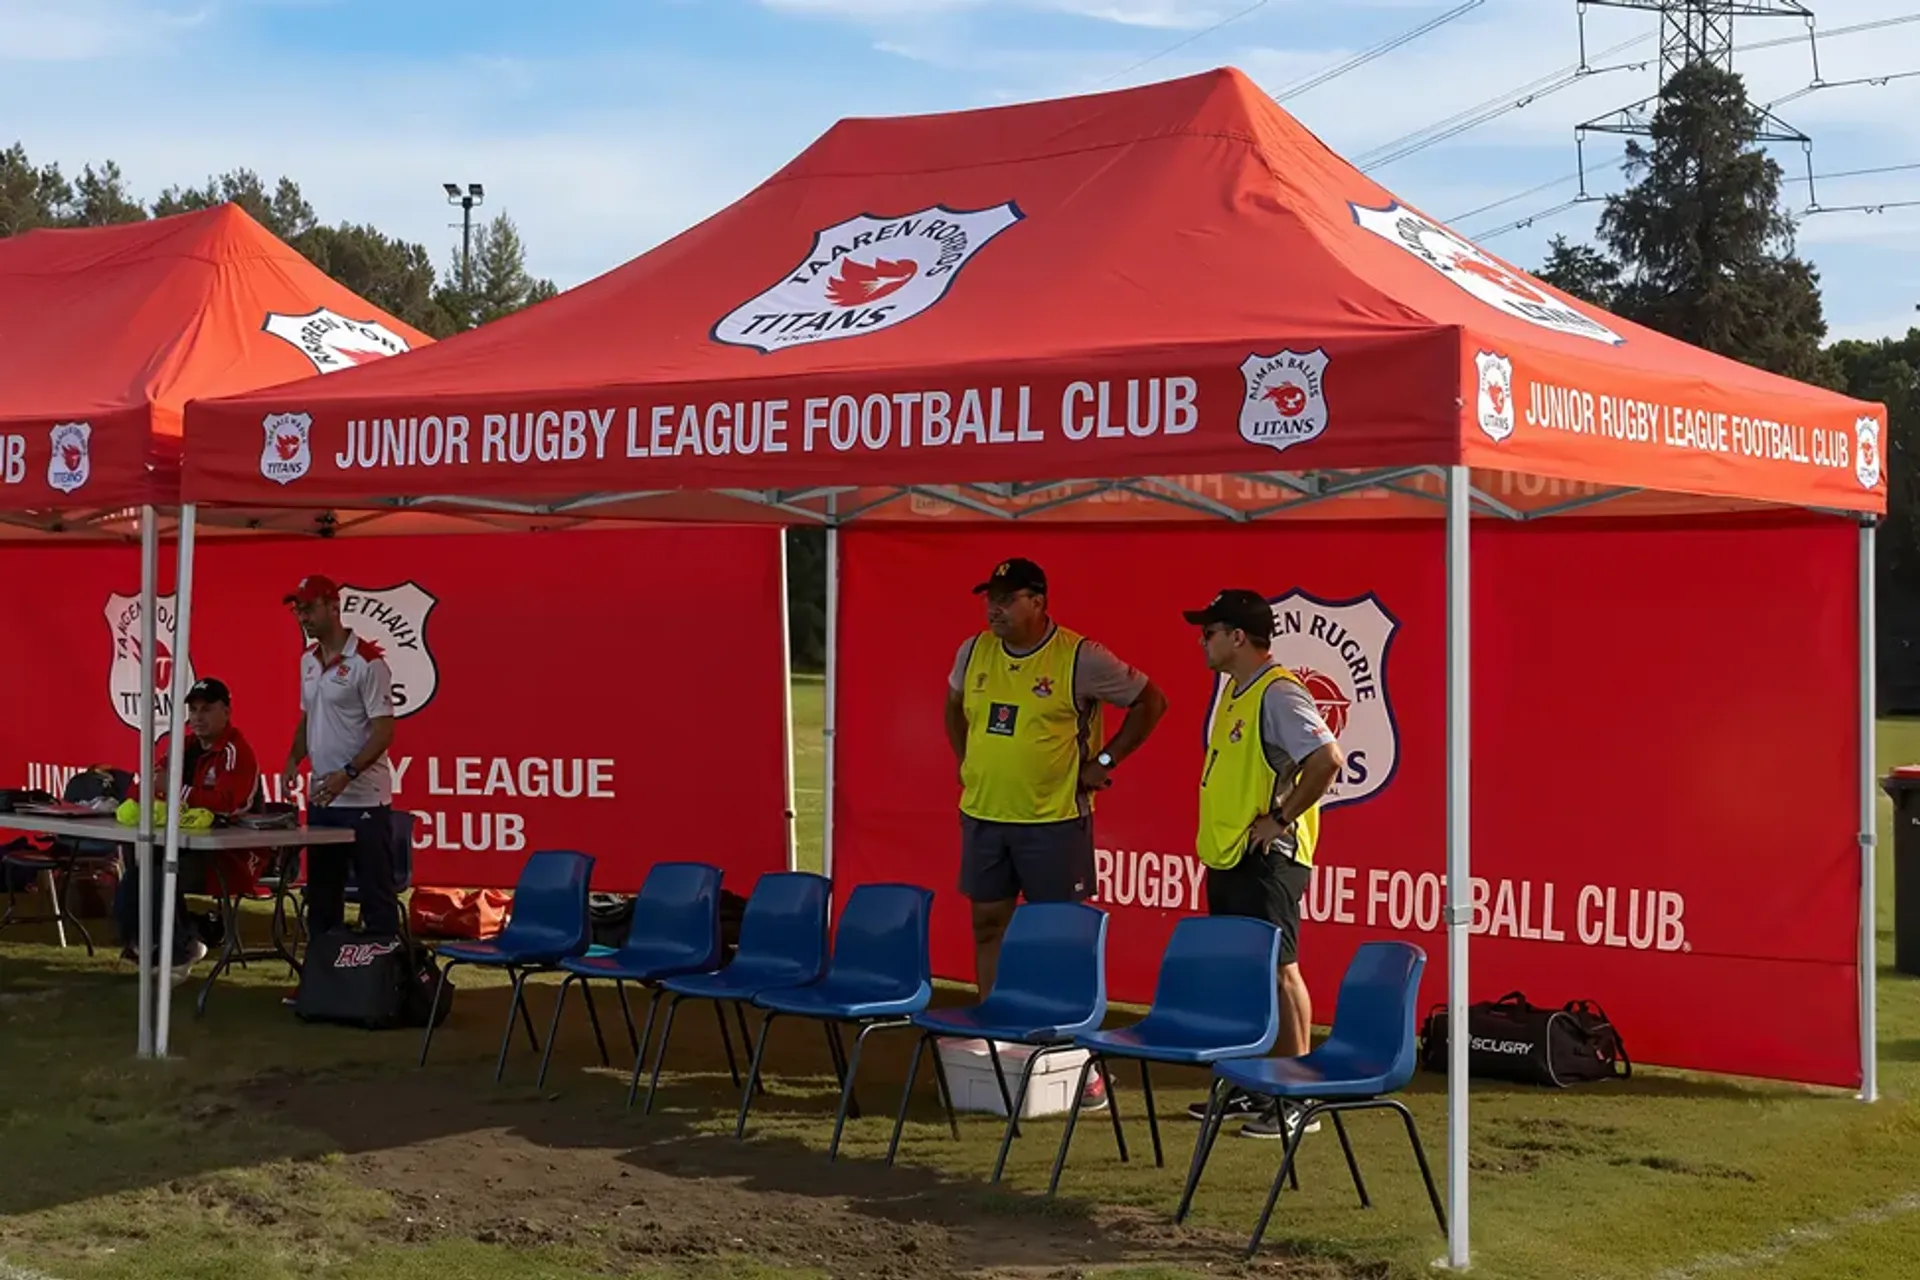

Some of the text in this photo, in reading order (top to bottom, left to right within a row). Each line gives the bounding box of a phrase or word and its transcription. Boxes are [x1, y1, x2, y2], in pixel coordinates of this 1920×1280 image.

[740, 304, 897, 335] TITANS
[335, 416, 470, 469] JUNIOR
[481, 408, 616, 463] RUGBY
[626, 399, 789, 458] LEAGUE
[803, 386, 1044, 452] FOOTBALL
[1062, 376, 1198, 440] CLUB
[1525, 381, 1596, 434] JUNIOR
[1599, 395, 1660, 443] RUGBY
[1664, 406, 1729, 452] LEAGUE
[1731, 415, 1810, 464] FOOTBALL
[1812, 427, 1849, 468] CLUB
[428, 757, 615, 798] LEAGUE
[410, 810, 526, 851] CLUB
[1092, 848, 1207, 910] RUGBY
[1367, 869, 1565, 942] FOOBALL
